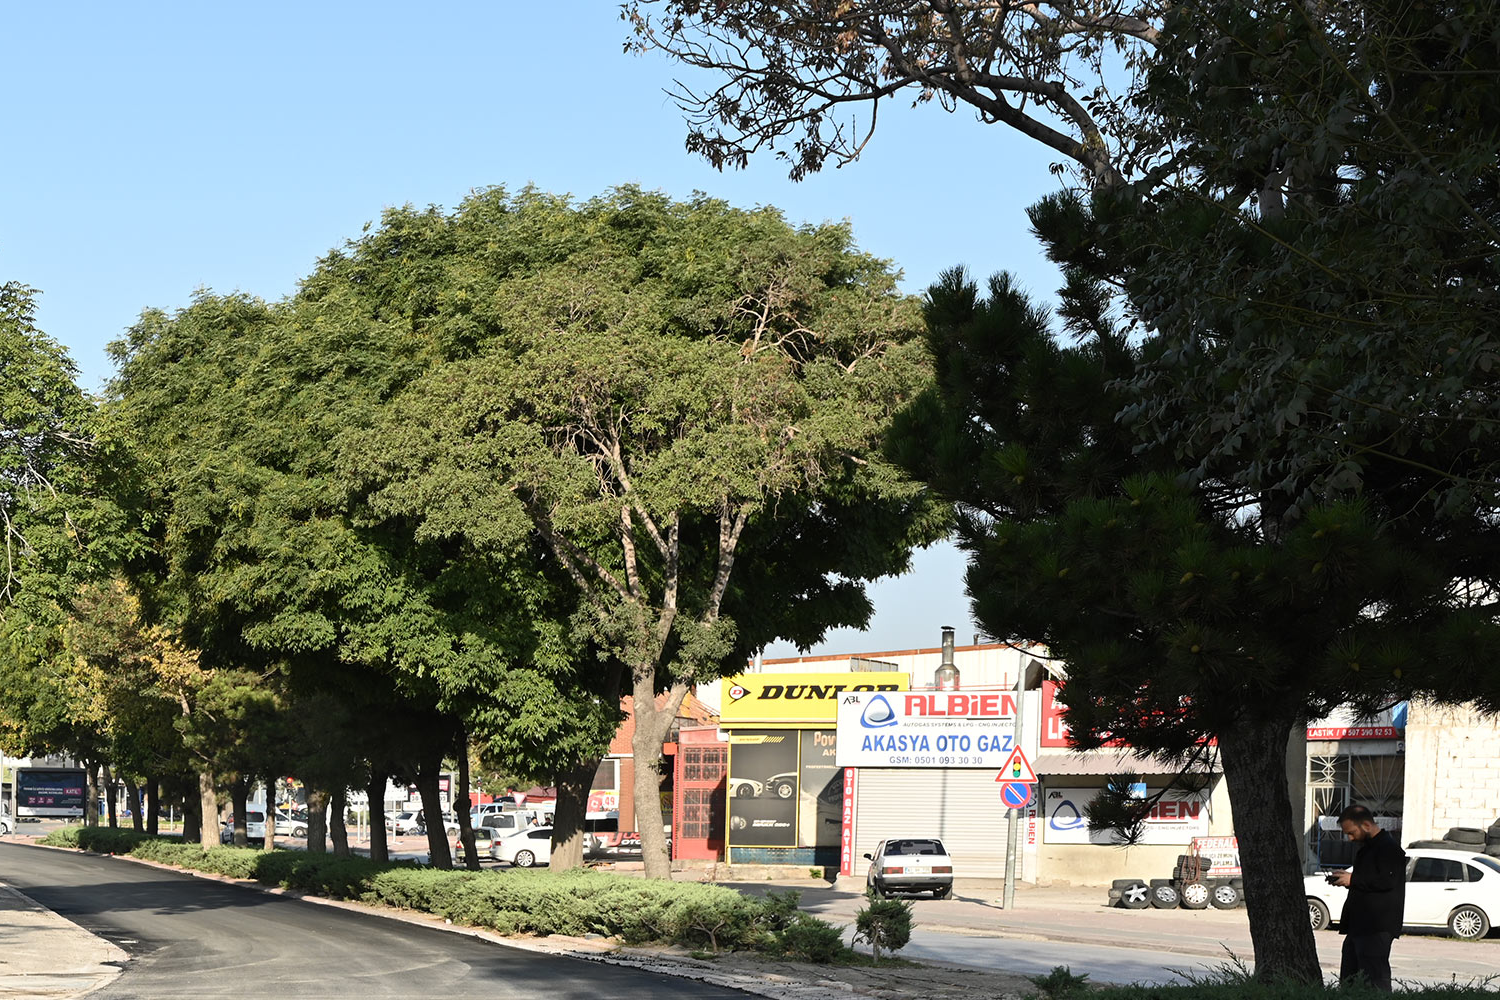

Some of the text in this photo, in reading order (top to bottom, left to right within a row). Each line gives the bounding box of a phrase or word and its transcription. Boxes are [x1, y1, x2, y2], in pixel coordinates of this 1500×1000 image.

[1309, 729, 1334, 737] LASTİK
[862, 734, 1013, 752] AKASYA OTO GAZ
[889, 756, 983, 764] GSM: 0501 093 30 30
[841, 768, 855, 871] OTO GAZ AYARI
[1196, 839, 1234, 849] FEDERAL
